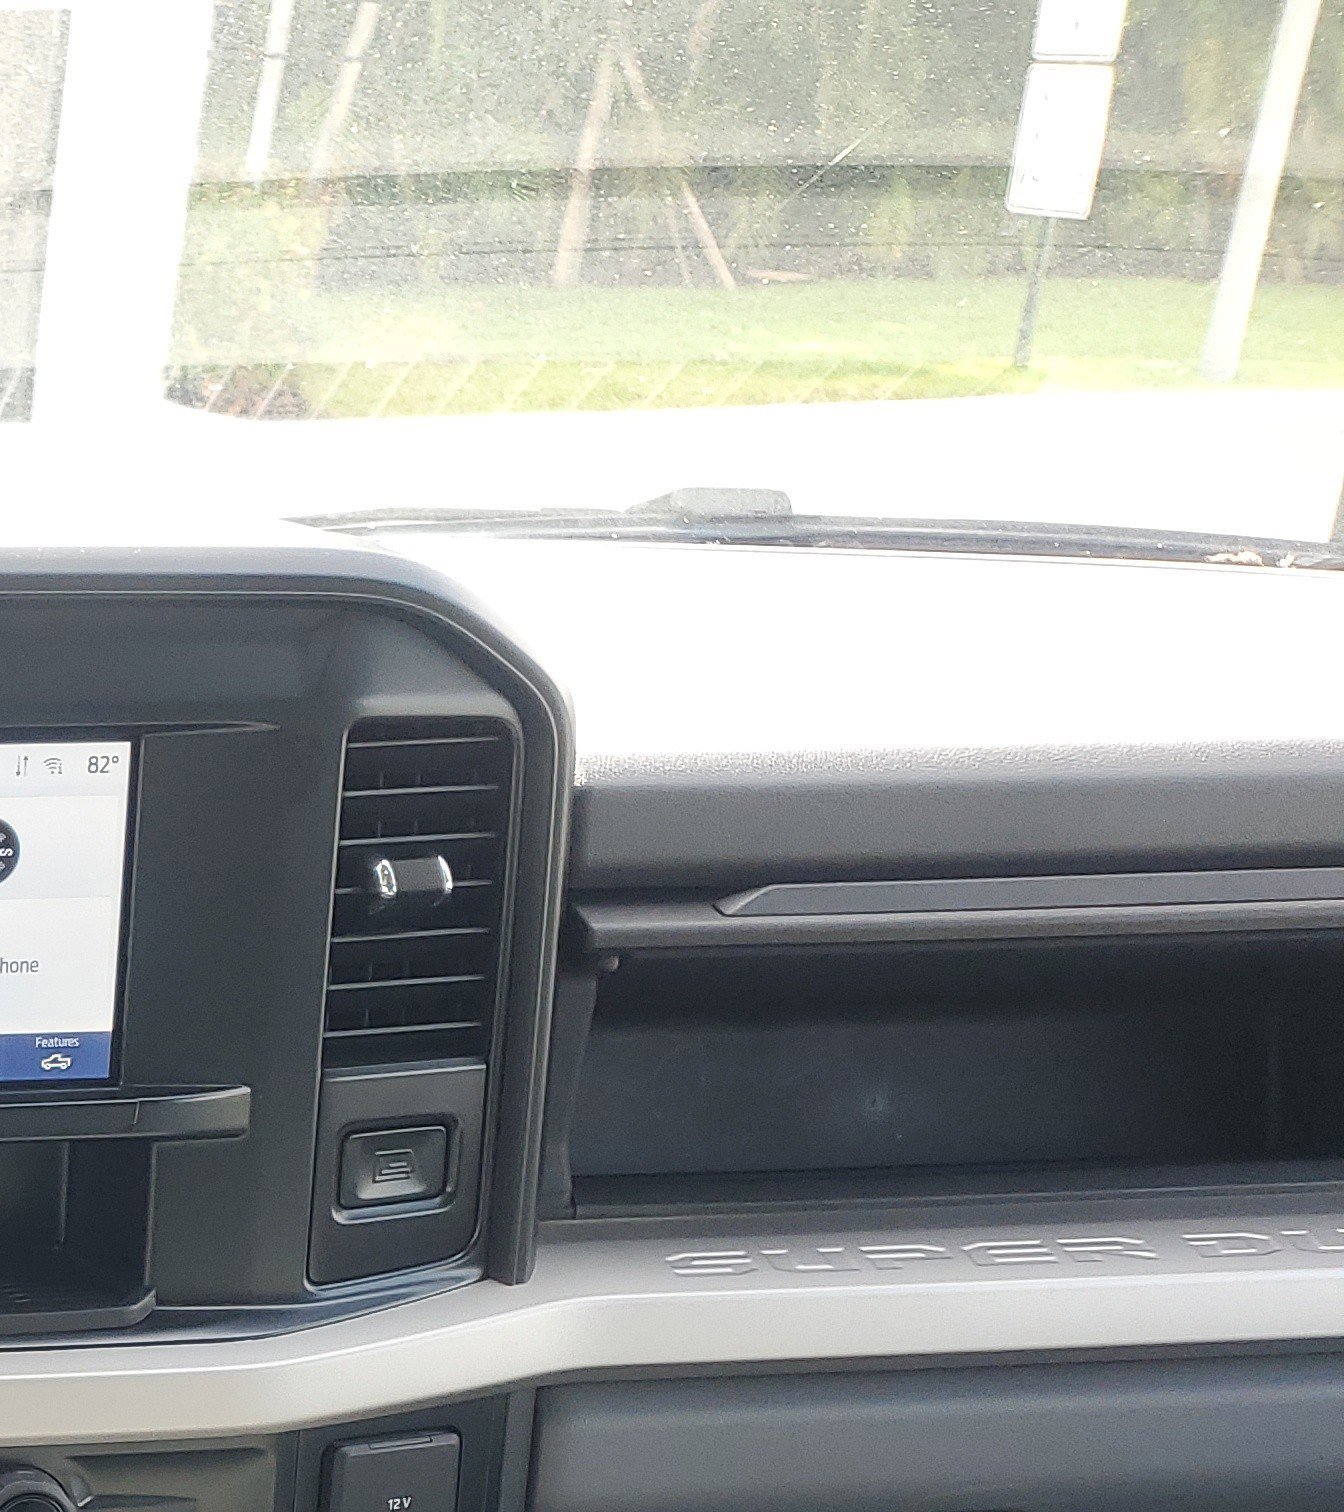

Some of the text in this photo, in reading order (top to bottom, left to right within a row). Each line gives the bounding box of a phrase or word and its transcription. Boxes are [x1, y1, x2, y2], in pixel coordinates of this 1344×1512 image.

[87, 755, 119, 774] 82°
[35, 1036, 79, 1048] Features
[665, 1236, 1161, 1279] SUPER
